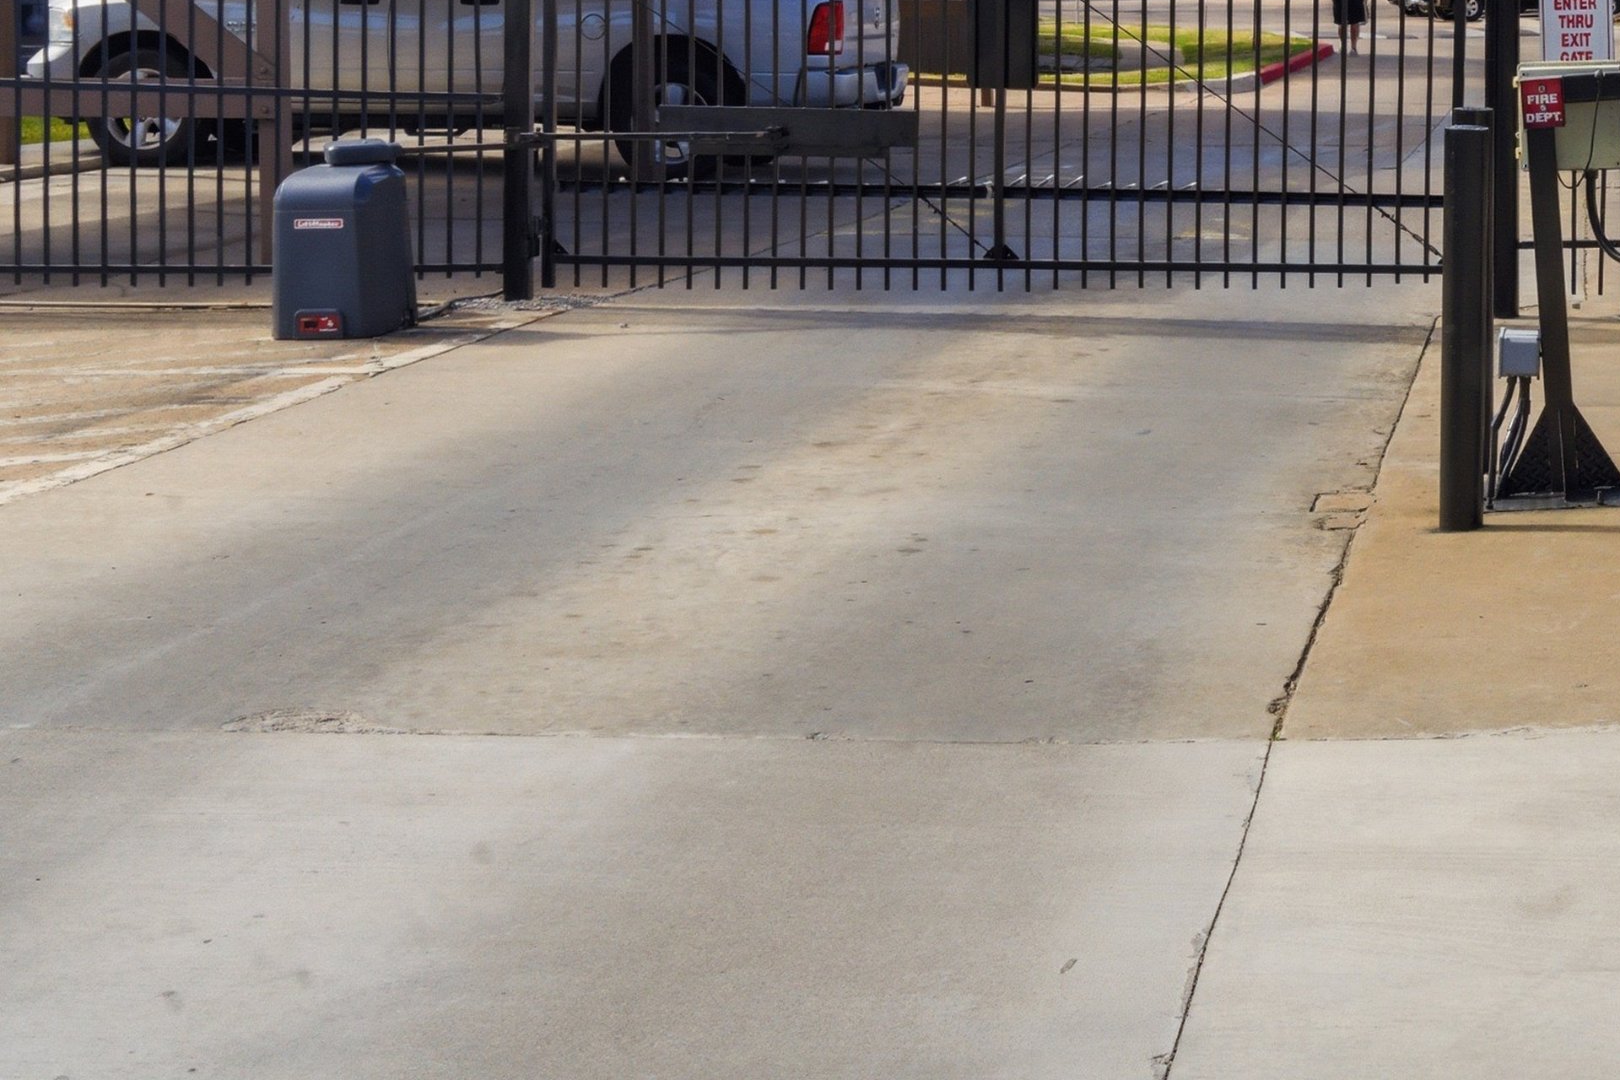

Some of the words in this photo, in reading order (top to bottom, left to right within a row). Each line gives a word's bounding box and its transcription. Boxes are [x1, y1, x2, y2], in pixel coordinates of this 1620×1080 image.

[1559, 15, 1593, 28] THRU
[1561, 33, 1591, 47] EXIT
[1527, 94, 1558, 104] FIRE
[1526, 112, 1562, 123] DEPT.
